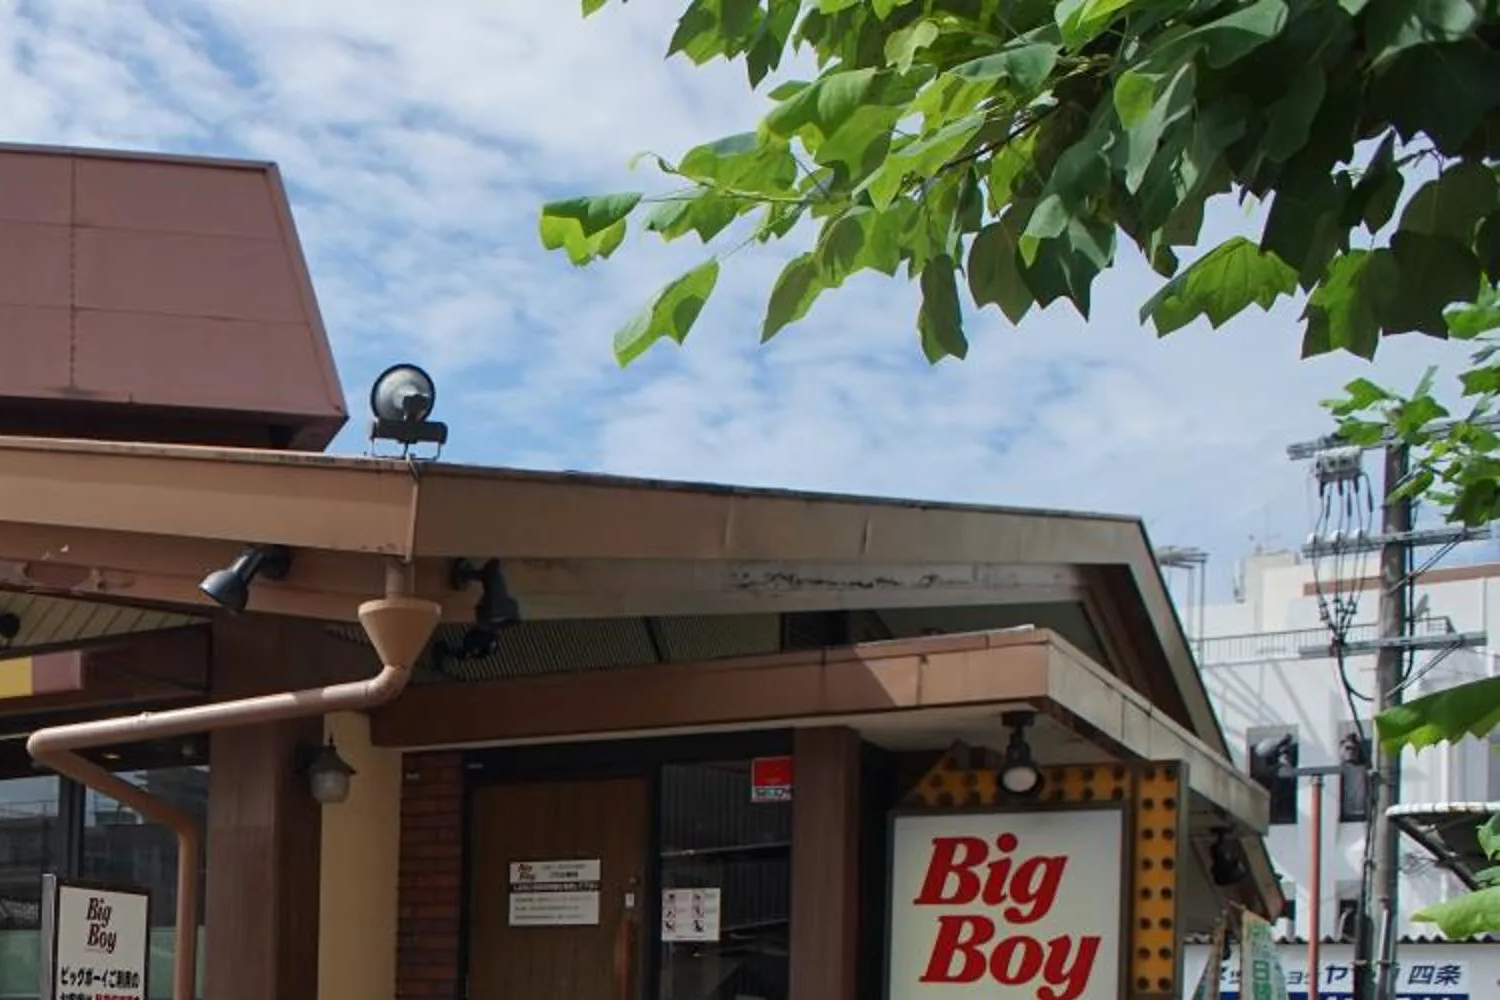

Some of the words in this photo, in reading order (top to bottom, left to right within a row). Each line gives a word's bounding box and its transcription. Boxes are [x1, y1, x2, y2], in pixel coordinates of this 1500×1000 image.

[913, 832, 1069, 924] Big
[86, 897, 113, 929] Big
[87, 923, 117, 954] Boy
[1408, 965, 1462, 985] 四条
